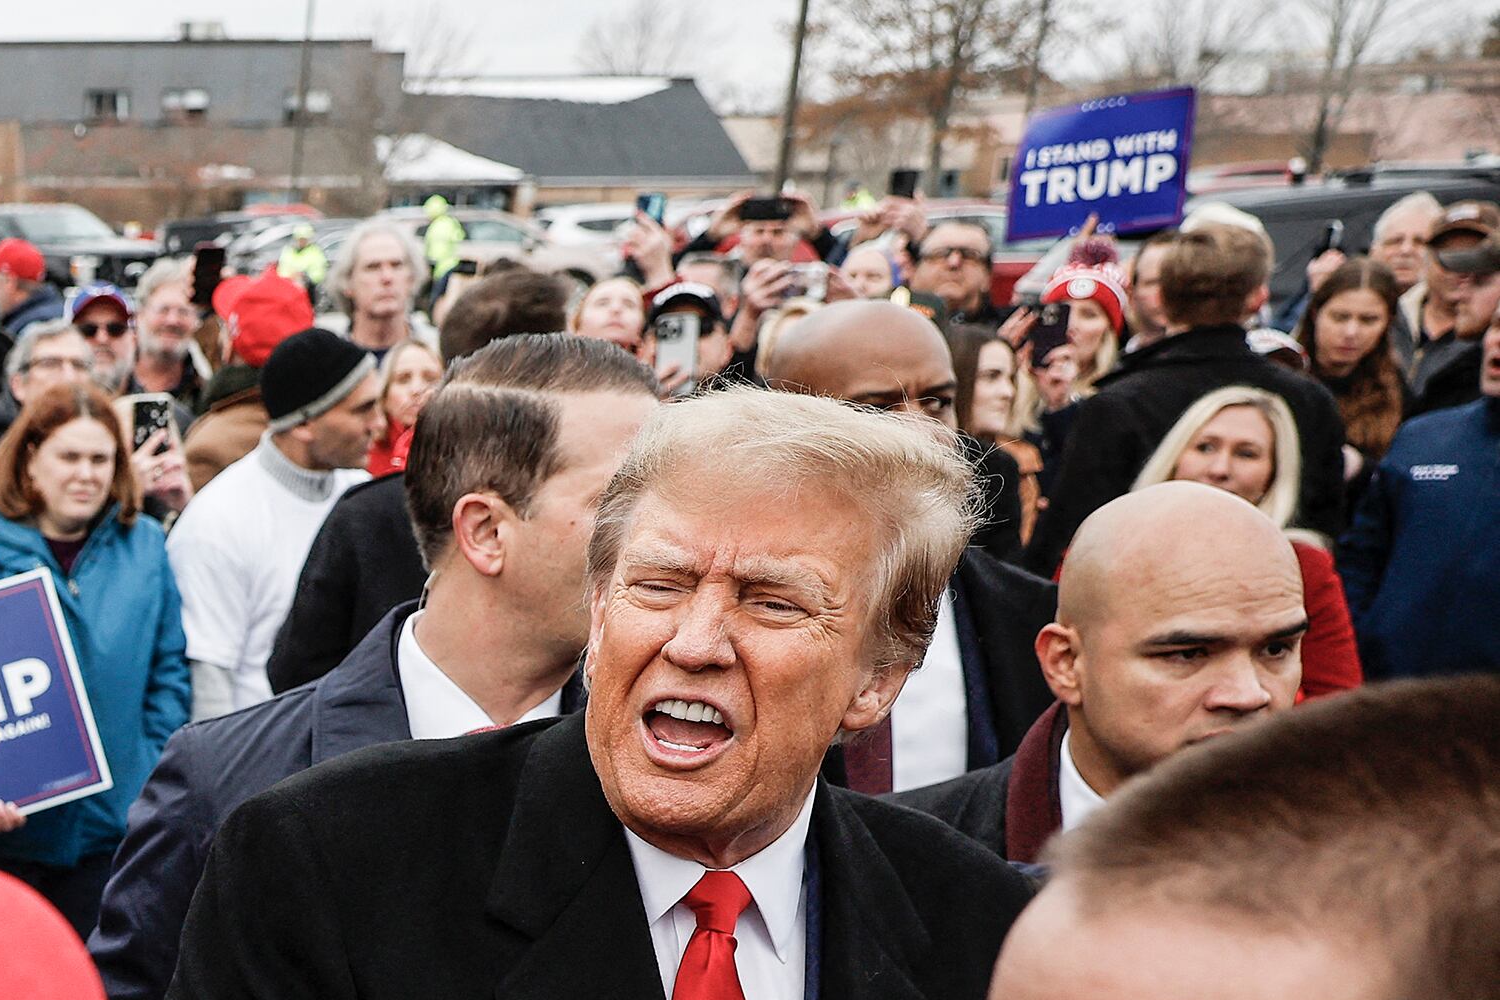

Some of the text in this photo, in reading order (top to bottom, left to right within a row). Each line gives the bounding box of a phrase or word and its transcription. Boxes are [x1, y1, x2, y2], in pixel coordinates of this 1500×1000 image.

[1025, 128, 1178, 169] I STAND WITH
[1020, 152, 1178, 207] TRUMP
